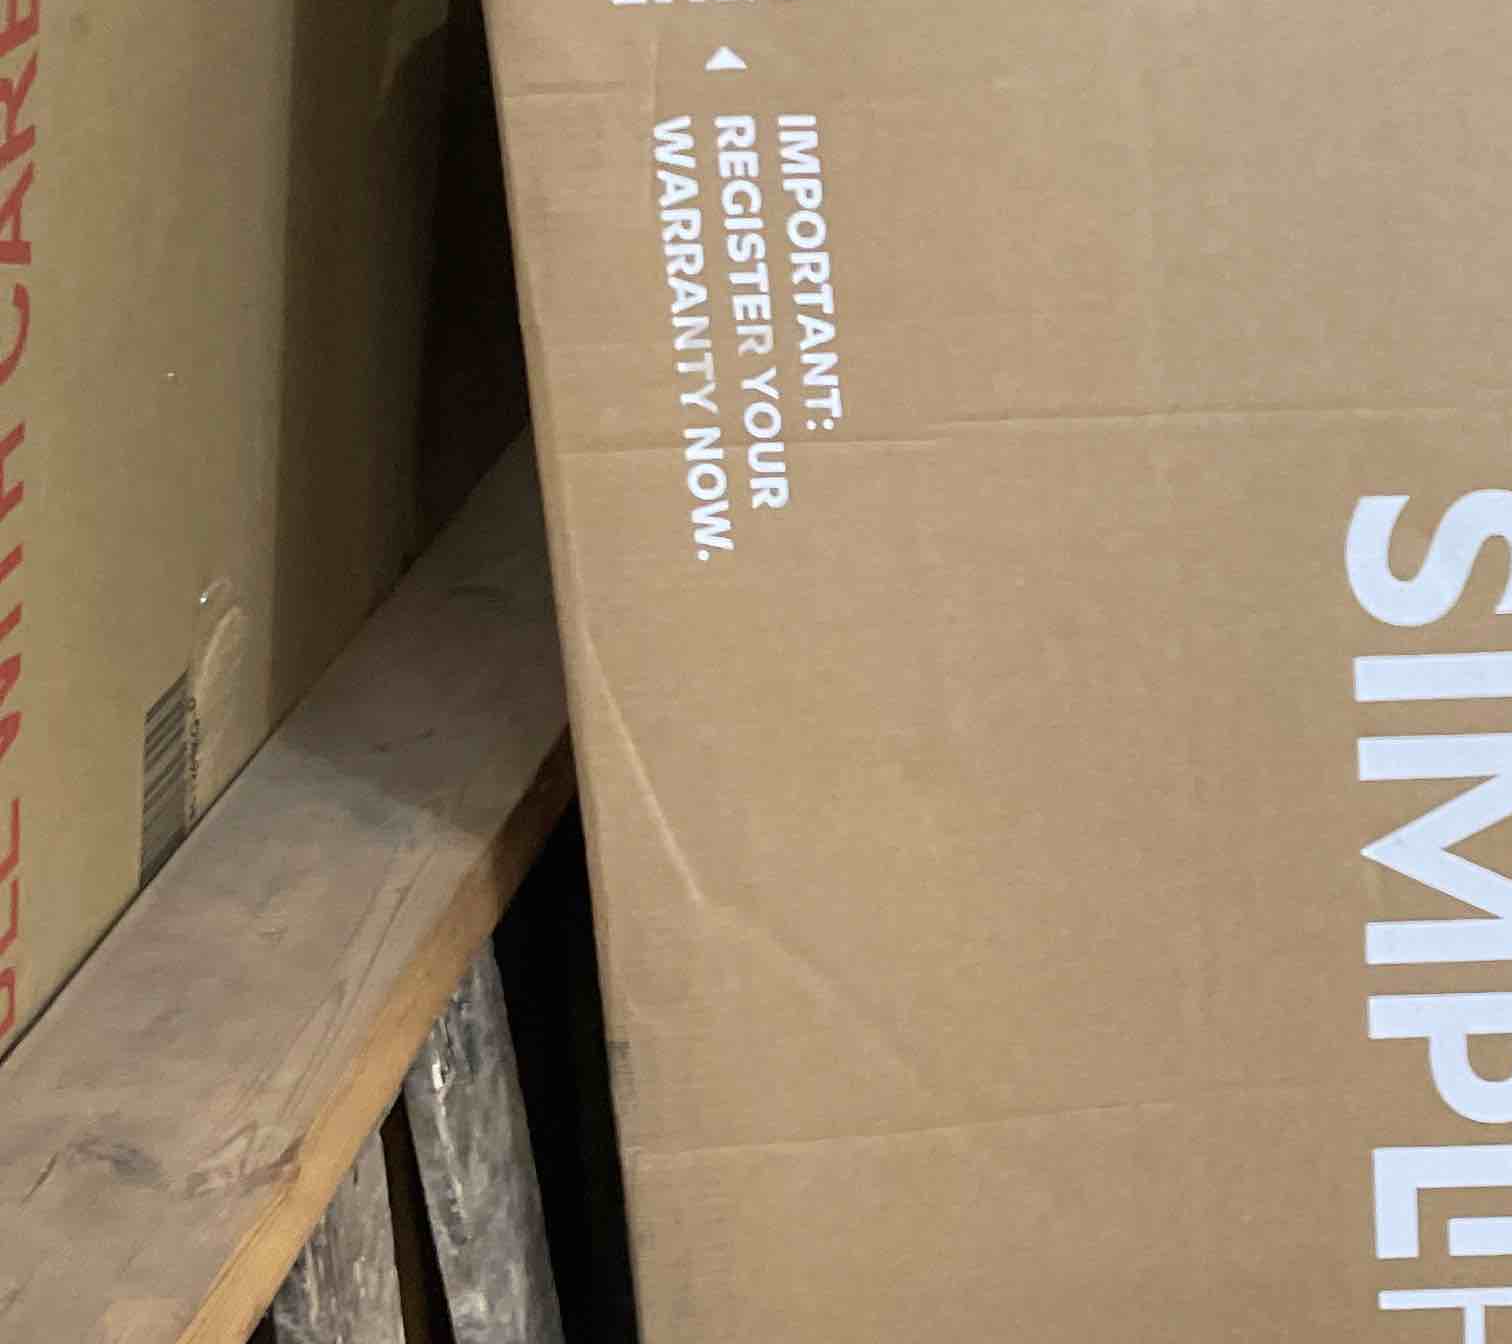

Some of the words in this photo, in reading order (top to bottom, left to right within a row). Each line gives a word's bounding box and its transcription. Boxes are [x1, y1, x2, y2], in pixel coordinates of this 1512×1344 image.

[653, 114, 719, 414] WARRANTY
[713, 114, 775, 357] REGISTER
[777, 113, 842, 432] IMPORTANT:
[683, 427, 735, 561] NOW.
[740, 366, 790, 510] YOUR
